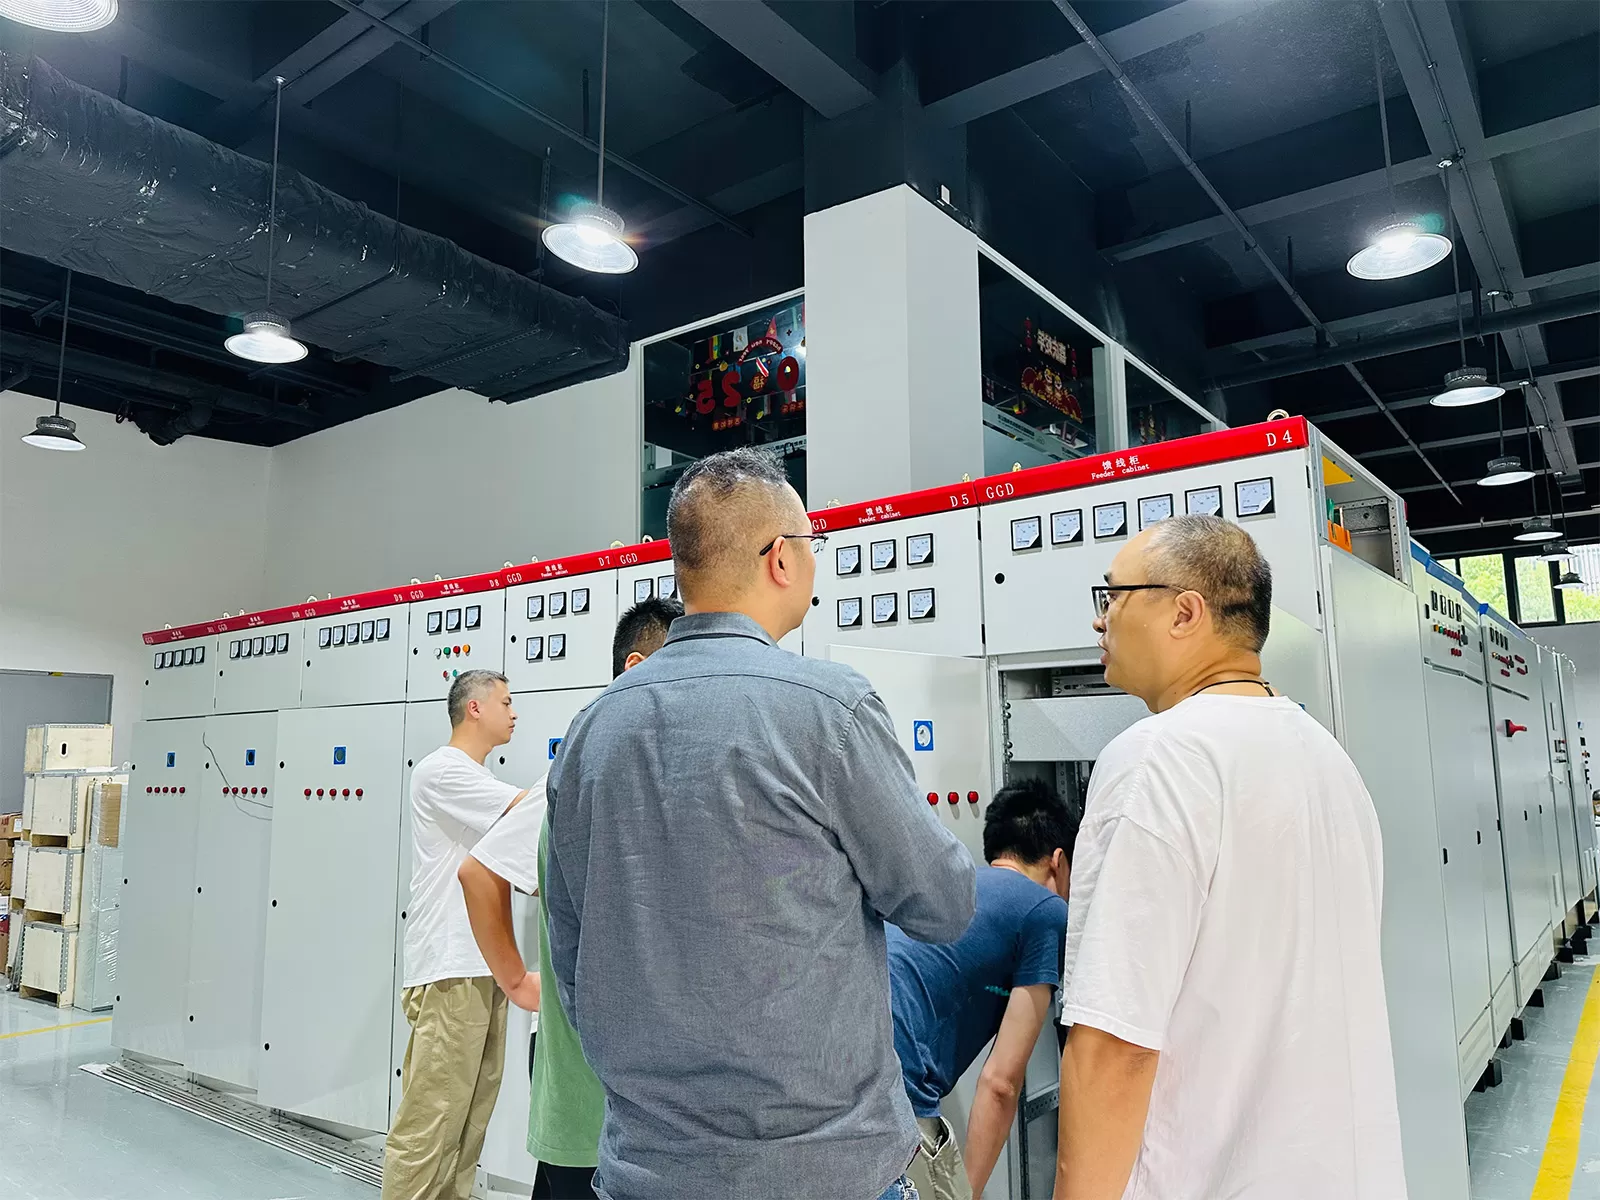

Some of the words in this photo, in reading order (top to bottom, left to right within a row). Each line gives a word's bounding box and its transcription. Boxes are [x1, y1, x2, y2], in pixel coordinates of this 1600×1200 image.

[1102, 455, 1140, 470] 馈线柜
[1091, 470, 1115, 480] Feeder
[1121, 464, 1150, 474] cabinet
[986, 482, 1015, 500] GGD
[811, 517, 828, 531] GD
[858, 516, 876, 524] Feeder
[880, 511, 901, 520] cabinet
[598, 555, 611, 567] D7
[620, 552, 638, 565] GGD
[506, 572, 522, 584] GGD
[410, 589, 424, 600] GGD
